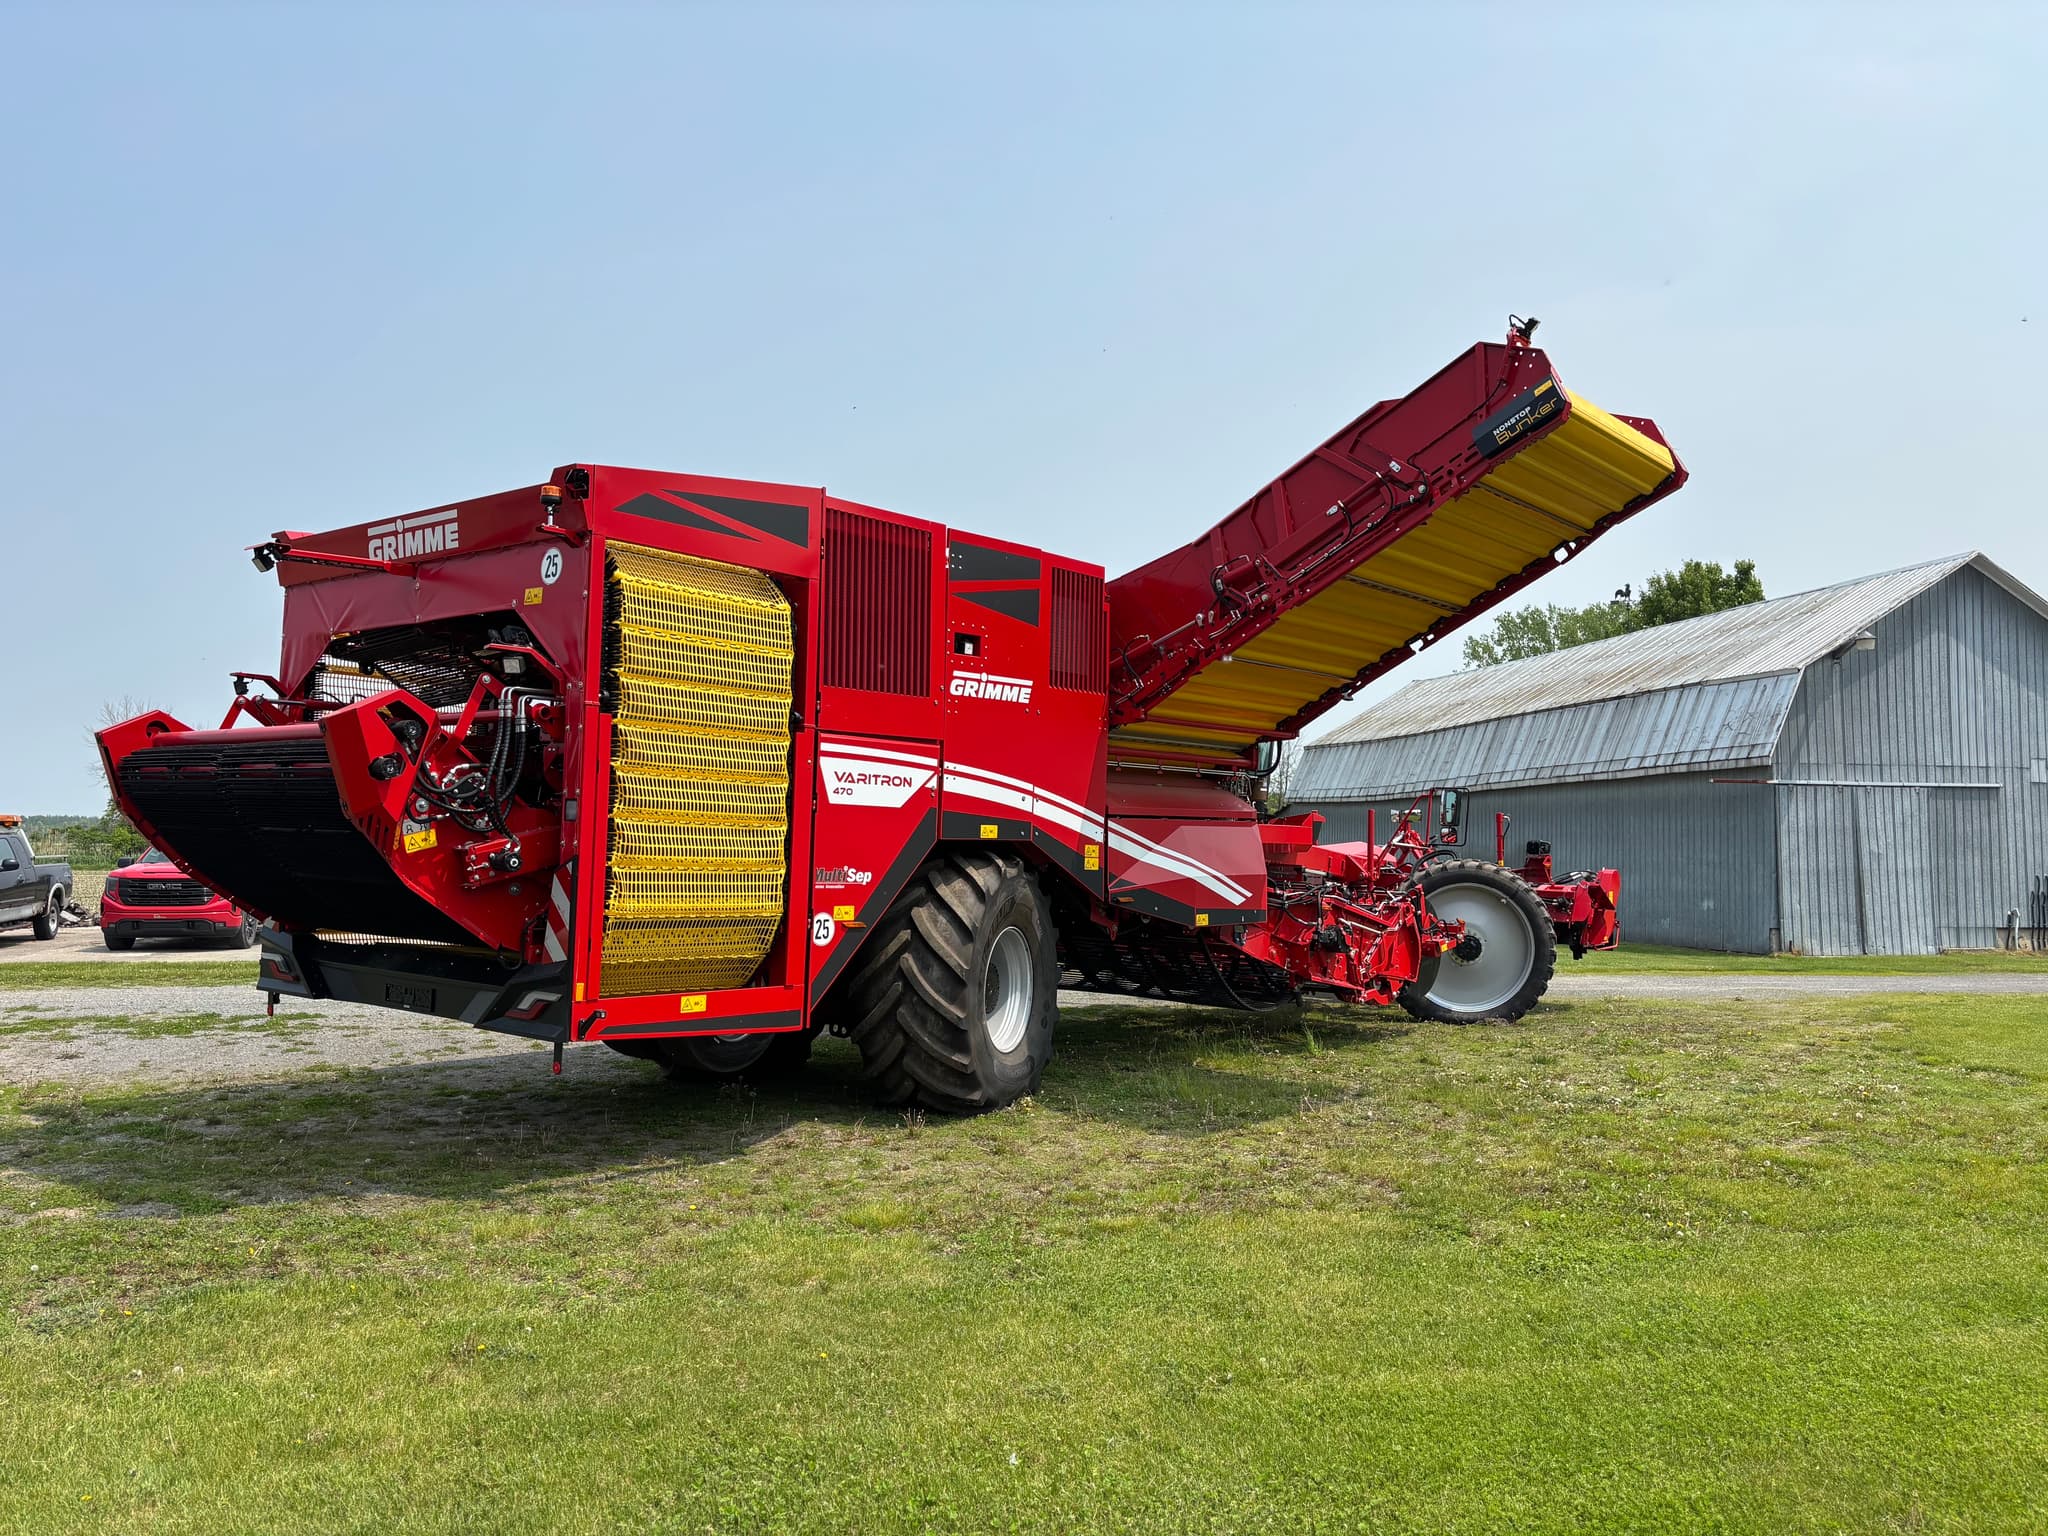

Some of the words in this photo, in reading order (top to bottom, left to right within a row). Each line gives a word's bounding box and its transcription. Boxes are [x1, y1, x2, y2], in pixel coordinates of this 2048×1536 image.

[1493, 406, 1531, 435] NONSTOP
[368, 519, 459, 563] GRIMME
[544, 553, 559, 579] 25
[949, 672, 1032, 704] GRIMME
[833, 787, 853, 796] 470
[834, 771, 912, 788] VARITRON
[815, 919, 830, 940] 25
